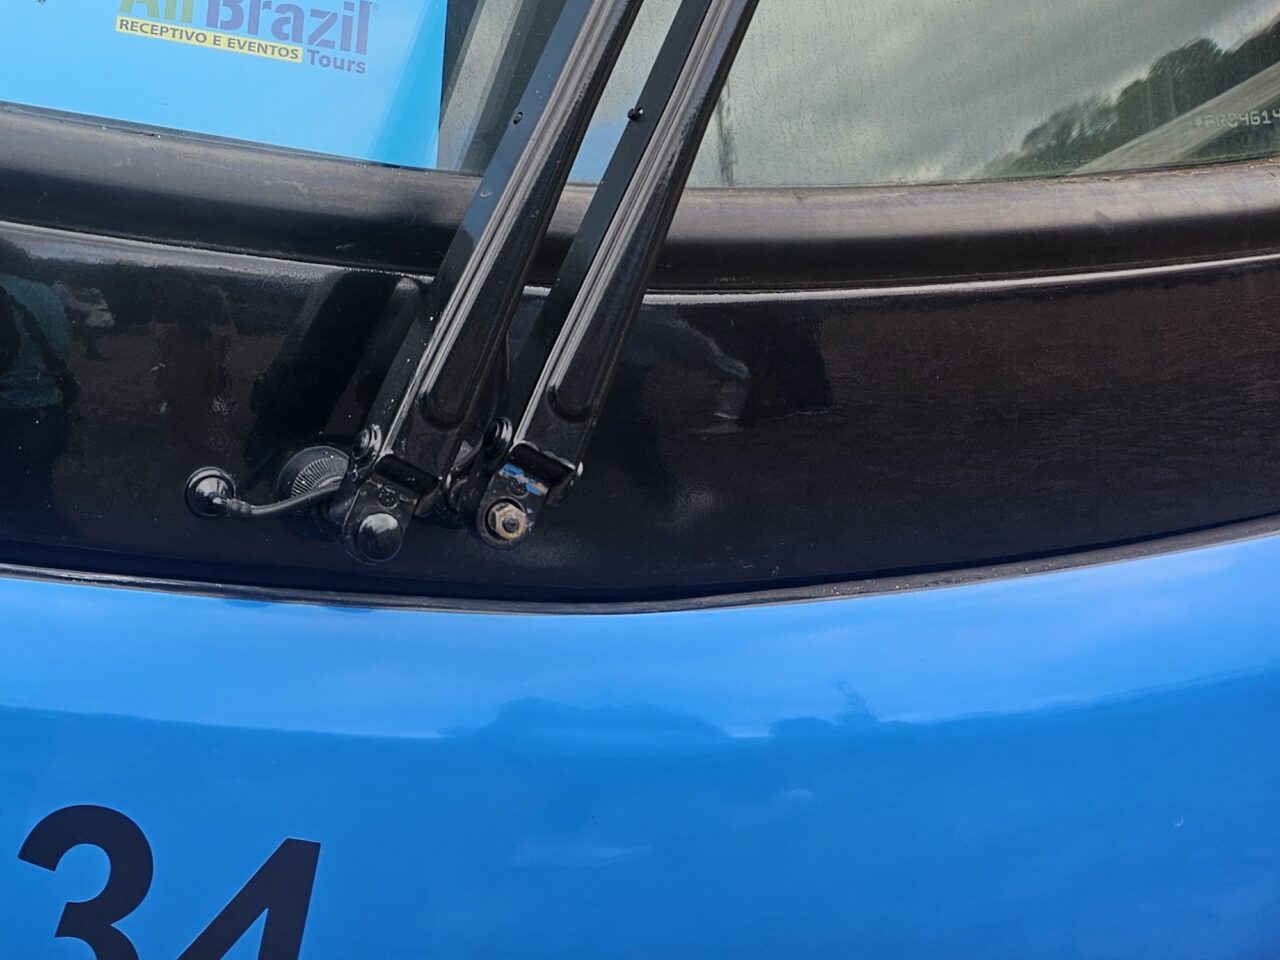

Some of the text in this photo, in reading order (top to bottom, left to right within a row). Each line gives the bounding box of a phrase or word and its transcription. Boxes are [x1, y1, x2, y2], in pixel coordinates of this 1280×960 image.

[119, 18, 300, 61] RECEPTIVO E EVENTOS
[306, 48, 367, 74] Tours
